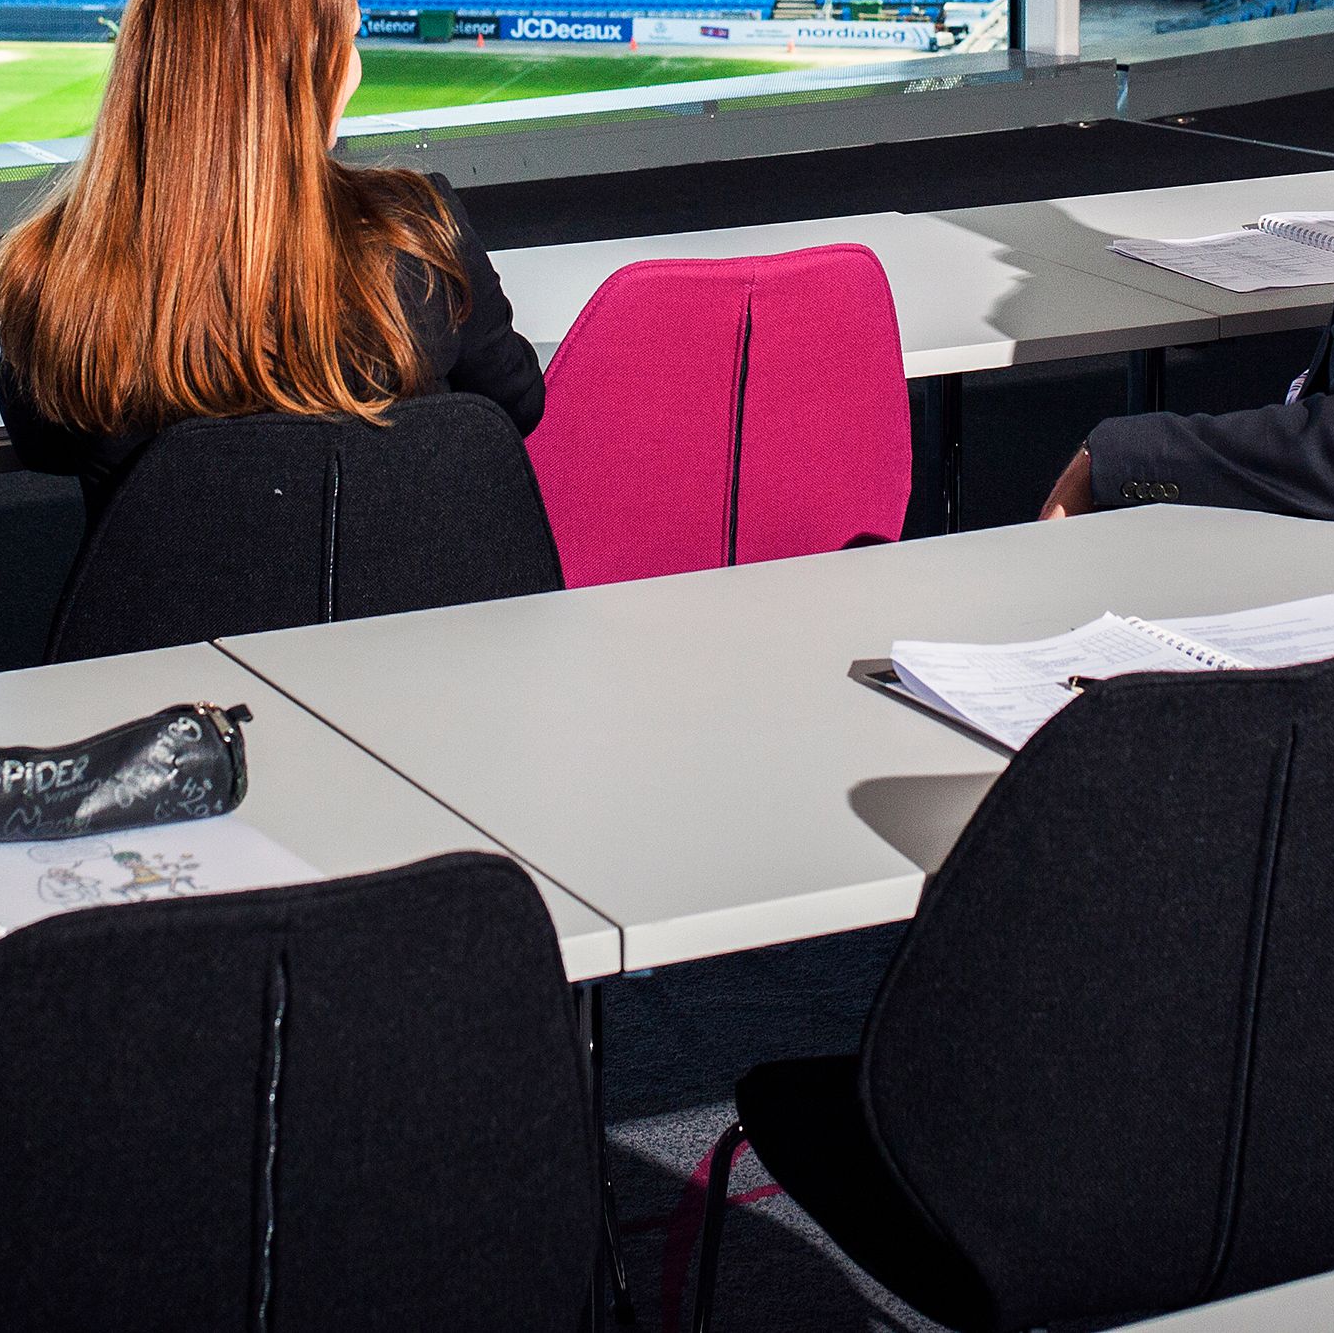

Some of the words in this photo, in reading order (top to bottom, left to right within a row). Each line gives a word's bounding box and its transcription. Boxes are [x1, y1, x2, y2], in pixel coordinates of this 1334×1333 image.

[367, 20, 415, 33] telenor
[454, 21, 496, 34] elenor
[510, 18, 622, 41] JCDecaux
[798, 27, 906, 44] nordialog
